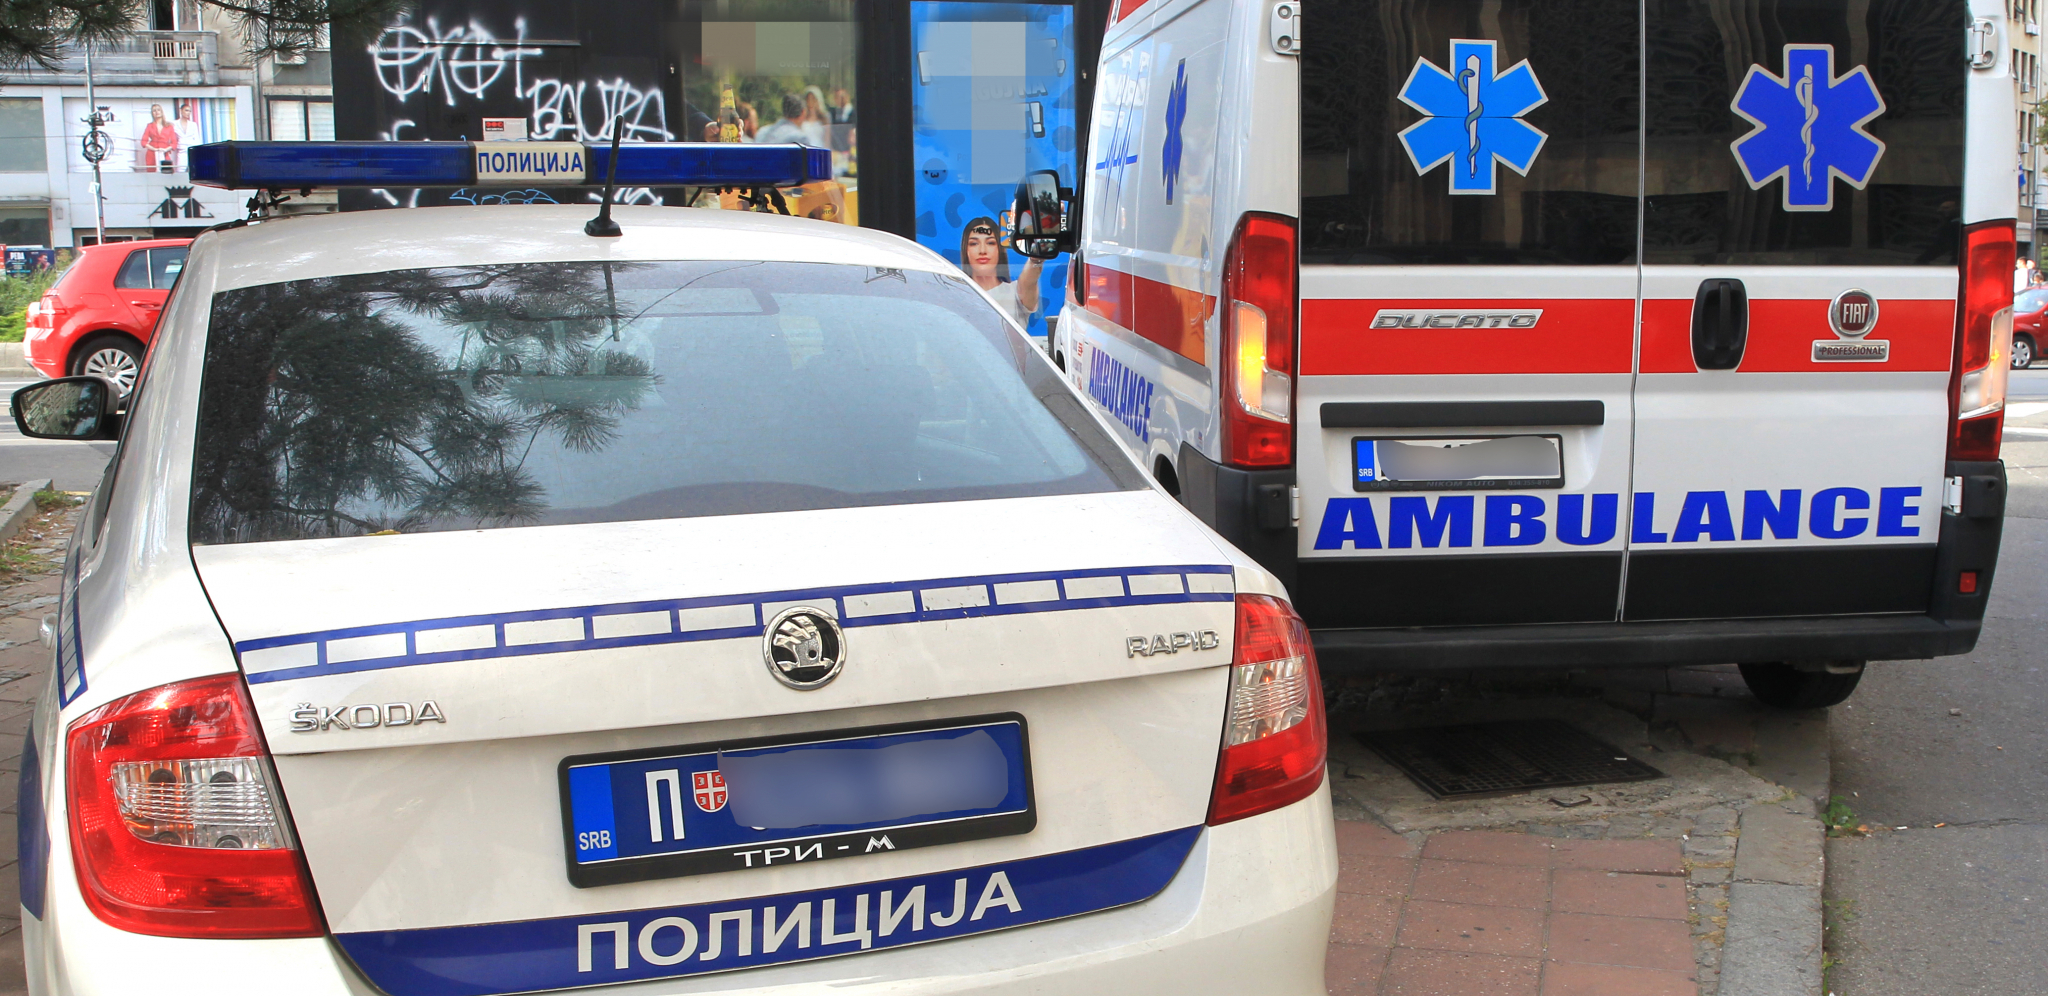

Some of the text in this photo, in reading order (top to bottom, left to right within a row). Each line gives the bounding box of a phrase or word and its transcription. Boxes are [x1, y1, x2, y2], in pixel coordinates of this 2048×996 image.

[478, 152, 584, 176] ПОЛИЦИЈА
[1373, 313, 1537, 328] DUCATO
[1843, 303, 1868, 324] FIAT
[1821, 346, 1883, 355] PROFESSIONAL
[1089, 346, 1154, 445] AMBULANCE
[1359, 468, 1374, 477] SRB
[1313, 486, 1922, 550] AMBULANCE
[1127, 629, 1220, 658] RAPID
[289, 700, 446, 733] ŠKODA
[578, 829, 612, 852] SRB
[733, 842, 823, 867] ТРИ
[577, 870, 1022, 973] ПОЛИЦИЈА
